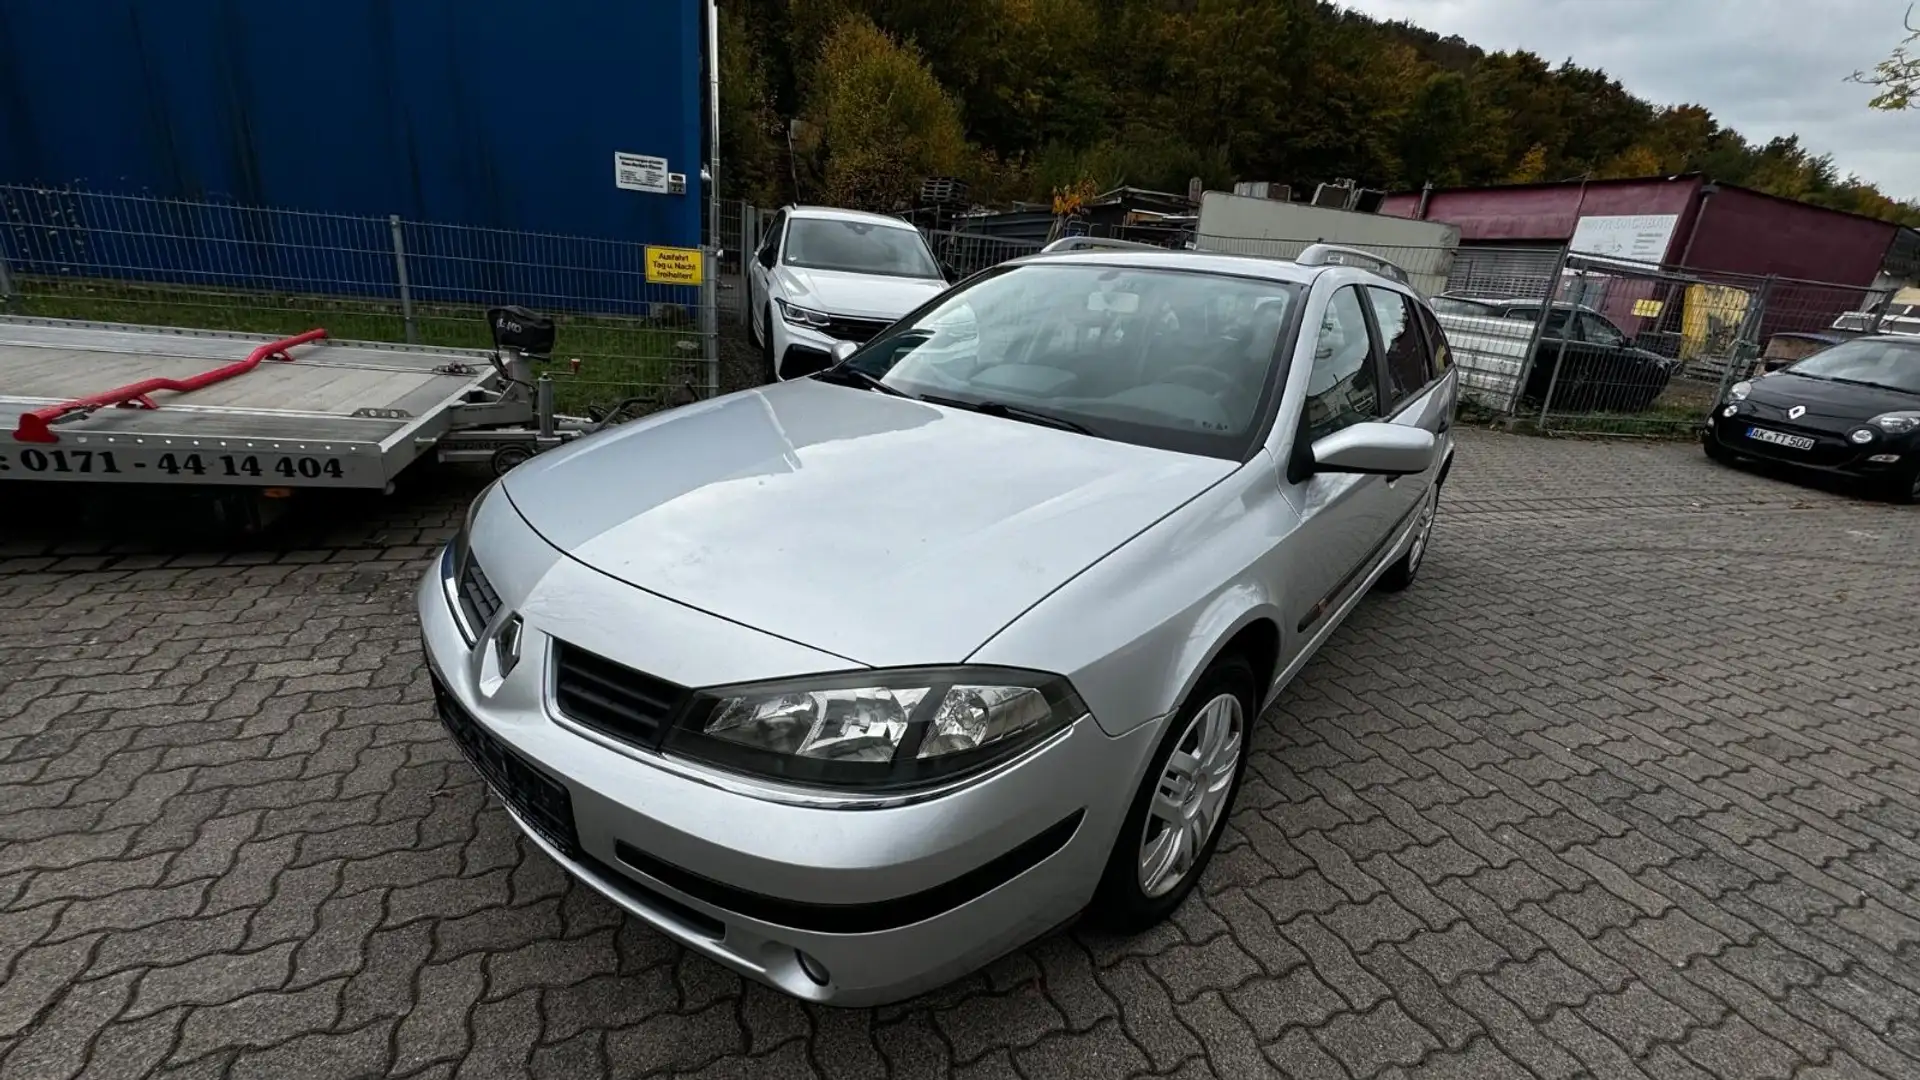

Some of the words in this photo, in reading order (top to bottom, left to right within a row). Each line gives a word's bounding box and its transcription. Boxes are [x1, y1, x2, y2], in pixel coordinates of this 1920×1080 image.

[659, 252, 689, 262] Ausfahrt
[652, 260, 666, 270] Tag
[675, 262, 696, 270] Nacht
[1752, 429, 1767, 439] AK
[1774, 433, 1789, 443] TT
[1788, 436, 1812, 449] 500
[20, 448, 122, 473] 0171
[157, 452, 207, 475] 44
[219, 454, 263, 477] 14
[275, 456, 344, 478] 404
